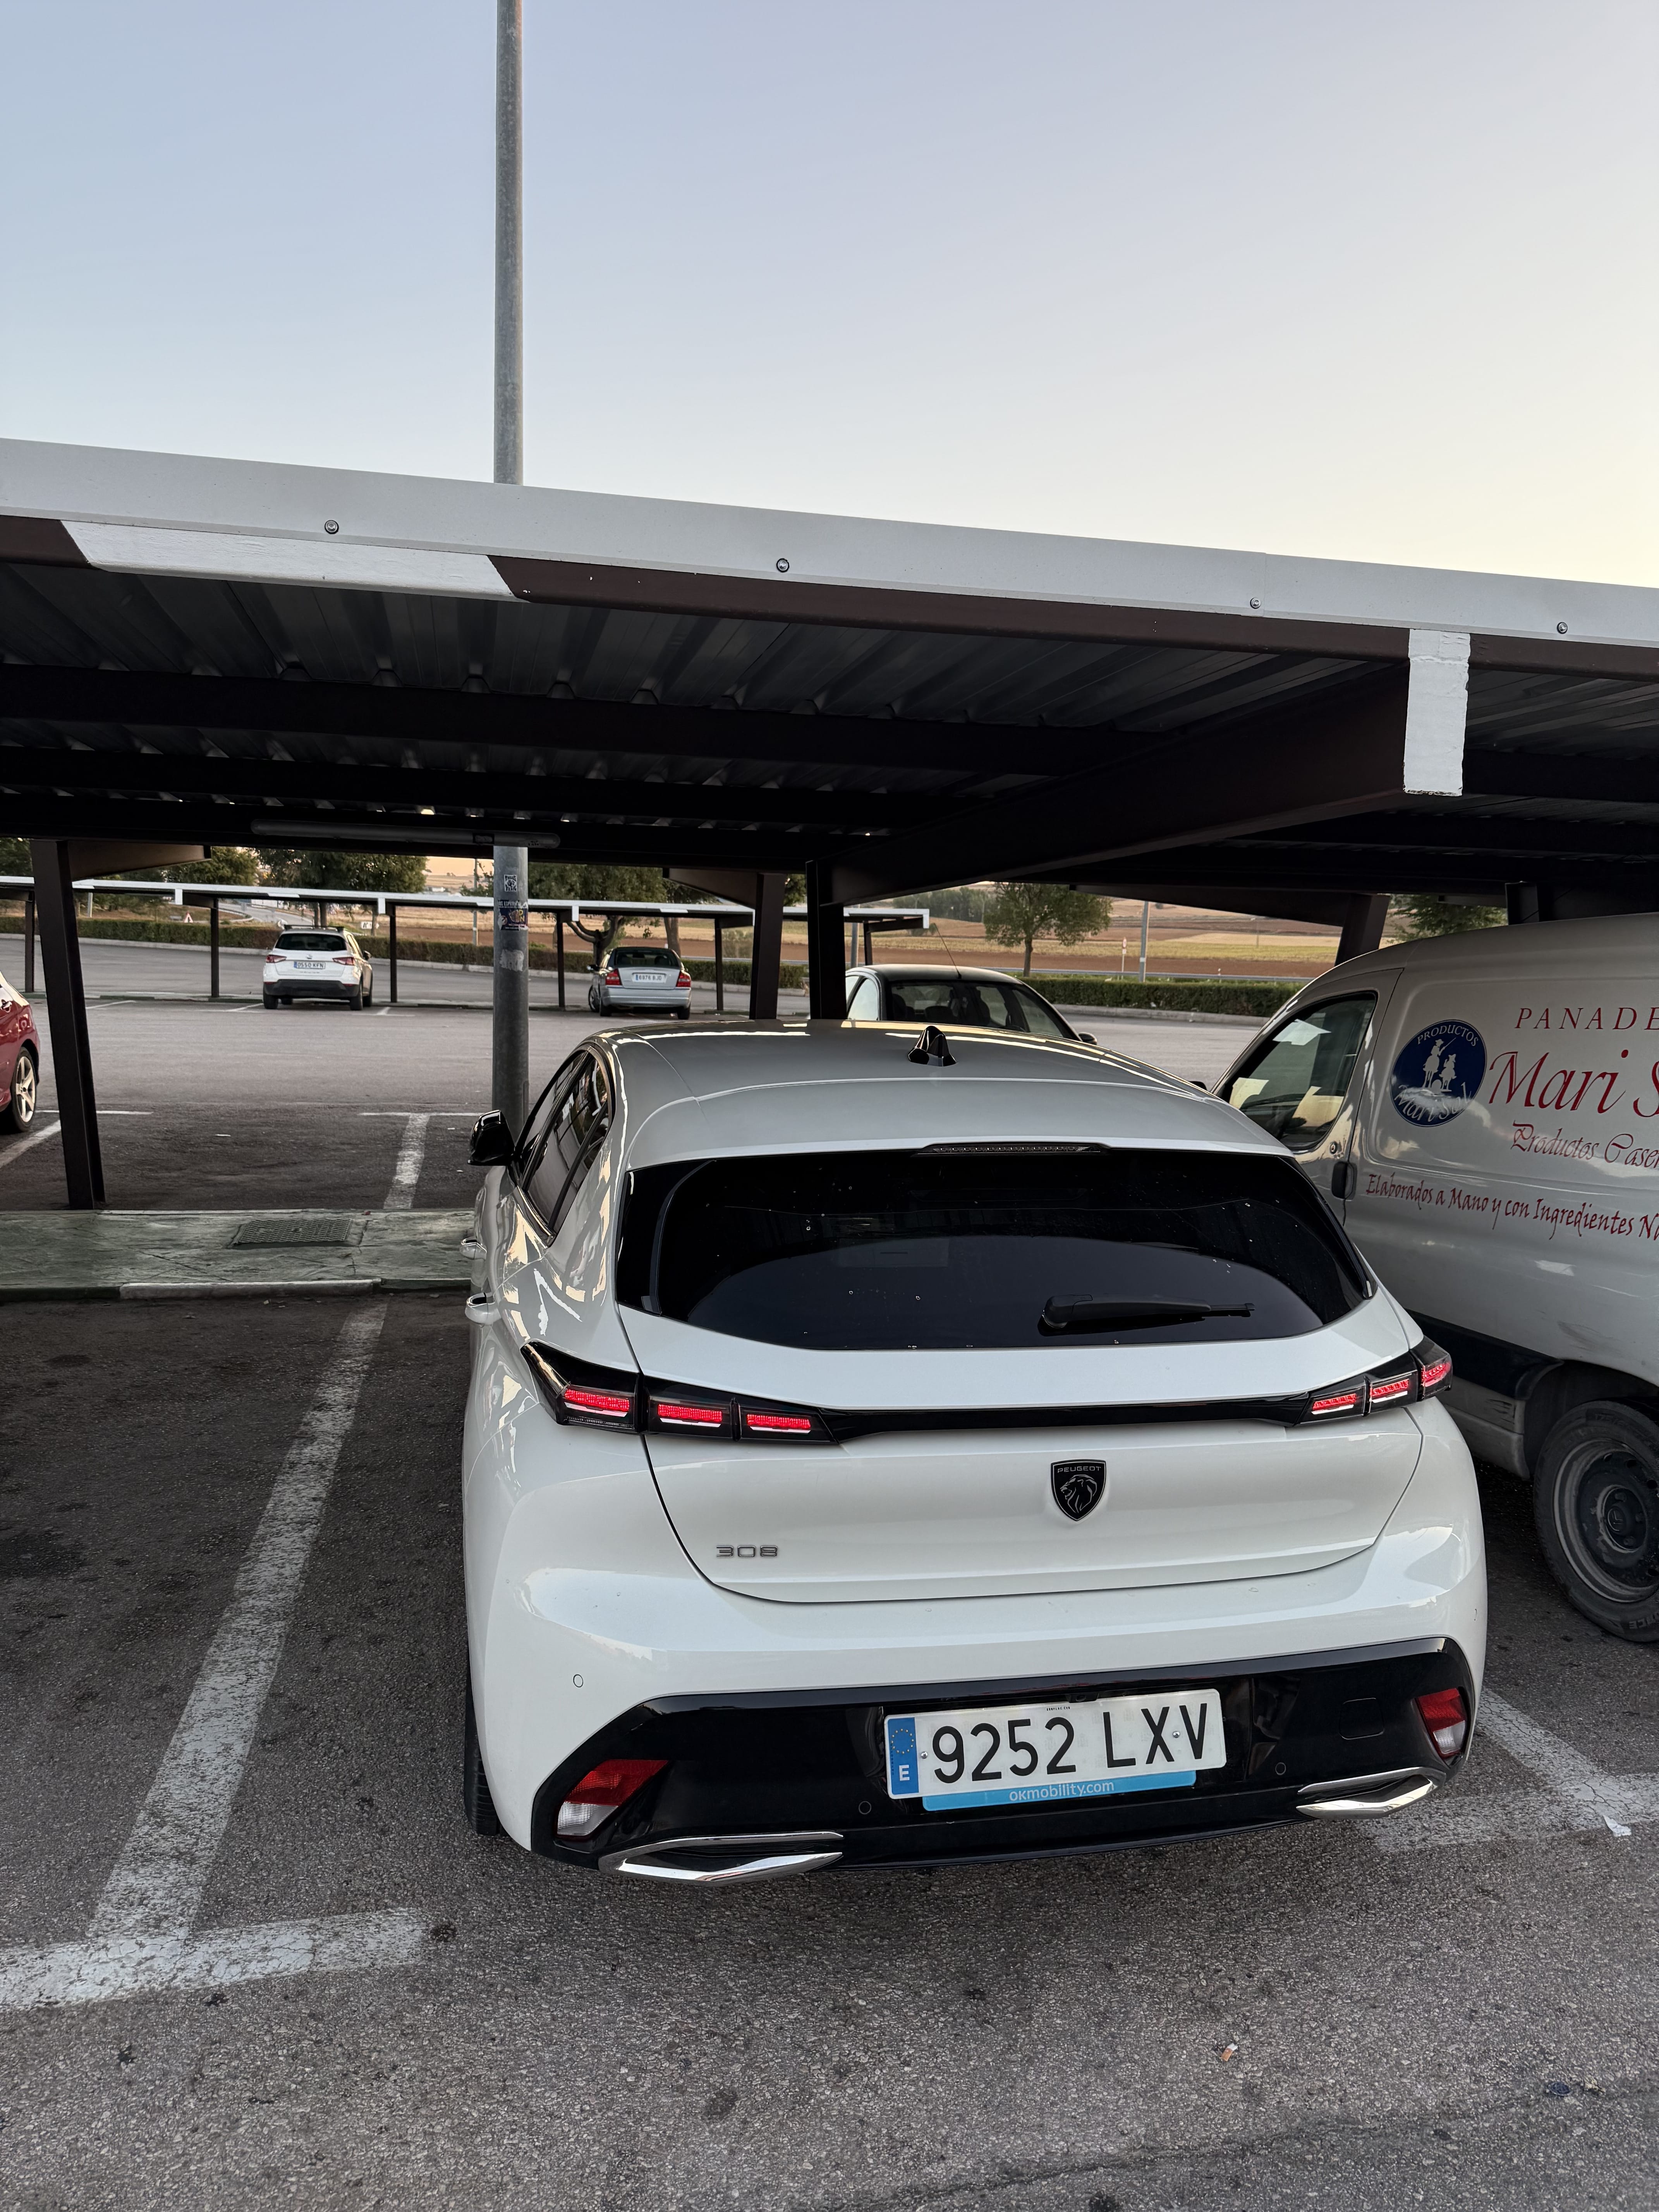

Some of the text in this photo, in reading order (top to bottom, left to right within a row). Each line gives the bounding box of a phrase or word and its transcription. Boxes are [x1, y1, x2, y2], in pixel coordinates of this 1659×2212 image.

[1417, 1025, 1479, 1046] PRODUCTOS
[1488, 1049, 1629, 1114] Mari
[1394, 1084, 1436, 1122] Mari
[1511, 1120, 1600, 1160] Productos
[1366, 1171, 1433, 1210] Elaborados
[1436, 1190, 1446, 1206] a
[1448, 1187, 1489, 1212] Mano
[1492, 1197, 1502, 1230] y
[1504, 1200, 1530, 1218] con
[1533, 1198, 1635, 1240] Ingredientes
[716, 1545, 778, 1558] 308
[933, 1716, 1076, 1784] 9252
[1103, 1703, 1207, 1768] LXV
[899, 1764, 910, 1781] E
